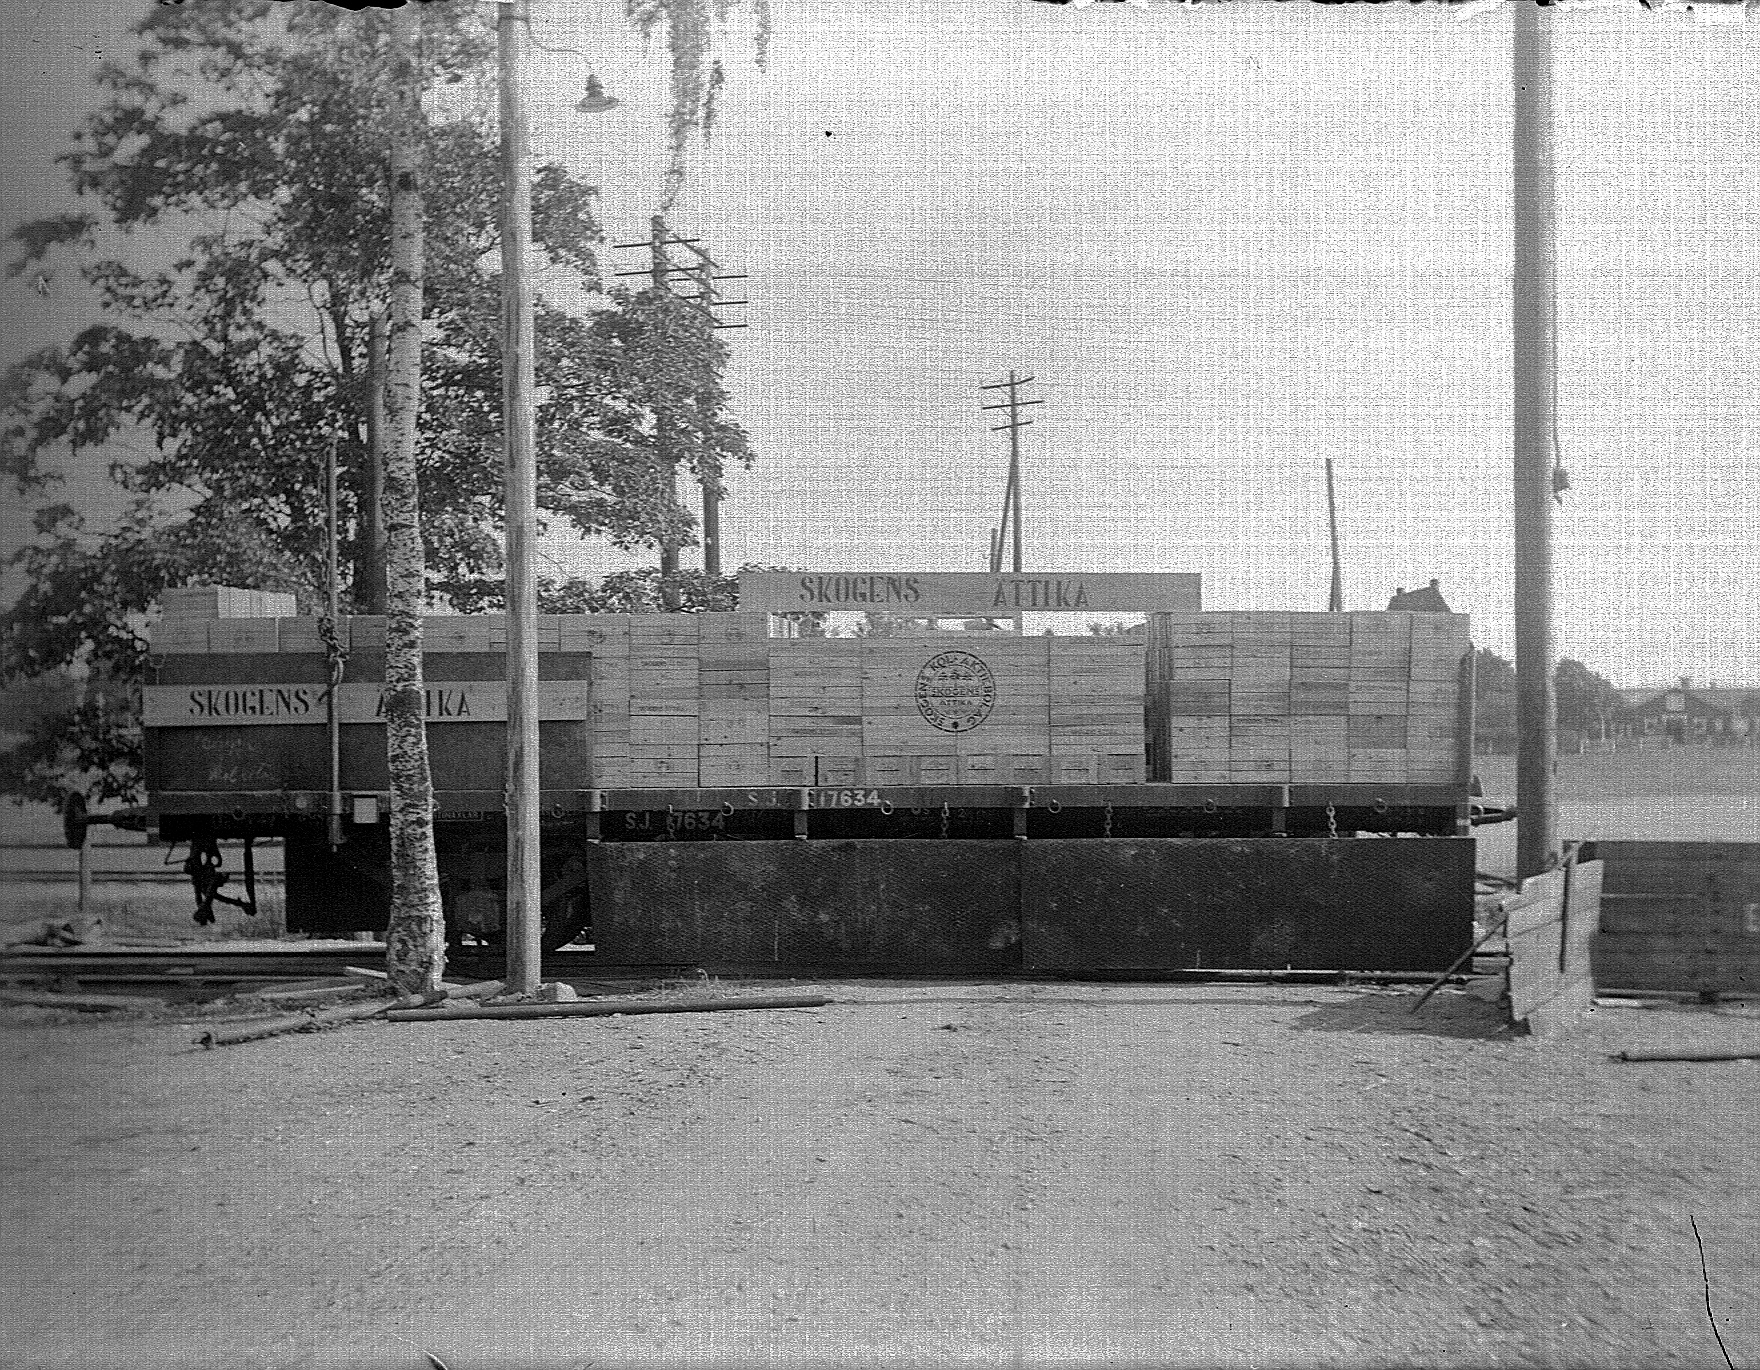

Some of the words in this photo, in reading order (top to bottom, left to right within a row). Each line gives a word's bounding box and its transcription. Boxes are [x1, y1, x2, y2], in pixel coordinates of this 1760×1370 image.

[799, 576, 919, 603] SKOGENS
[189, 687, 309, 716] SKOGENS
[820, 789, 882, 807] 17634
